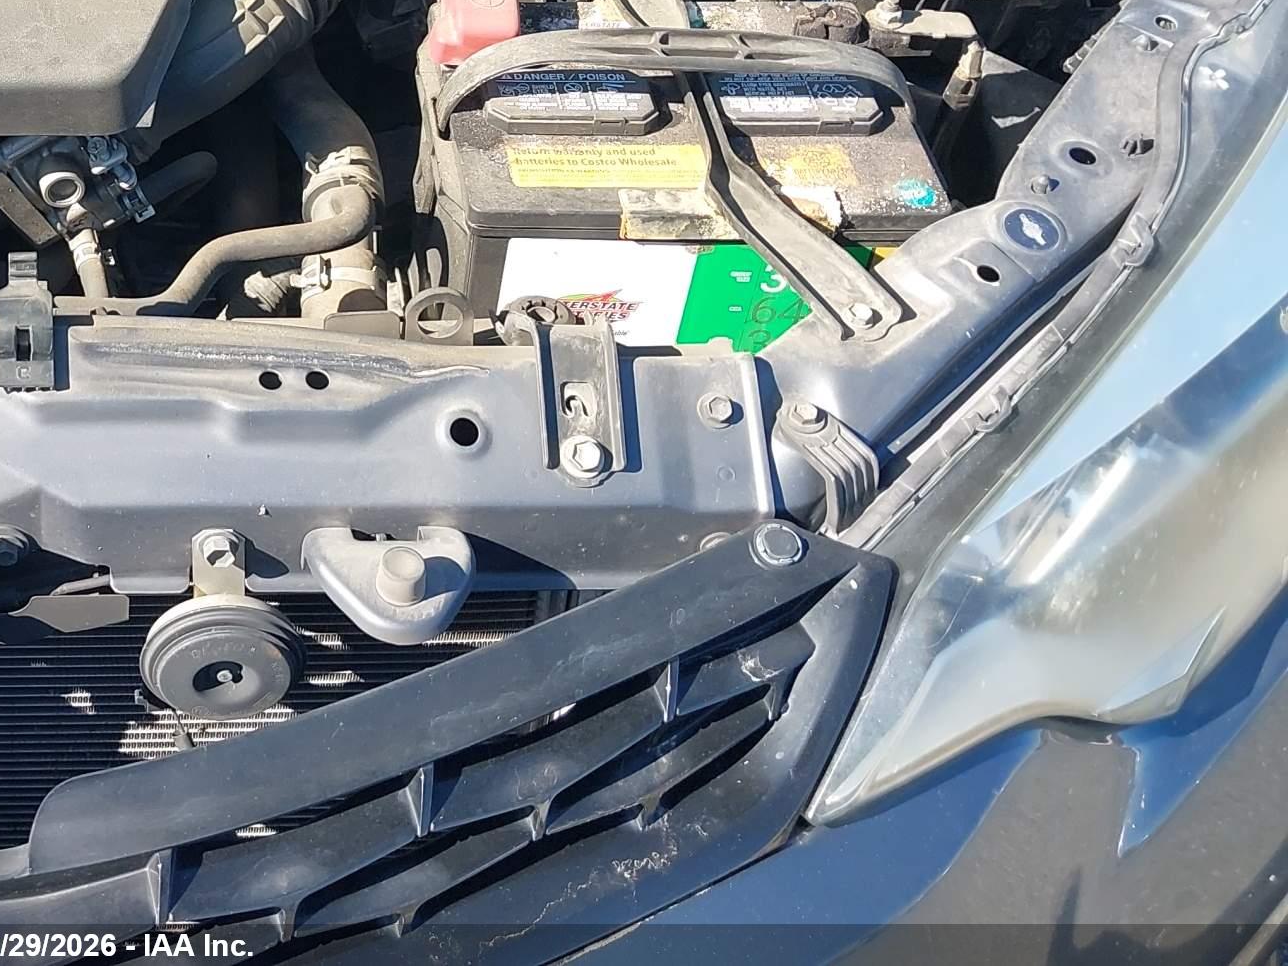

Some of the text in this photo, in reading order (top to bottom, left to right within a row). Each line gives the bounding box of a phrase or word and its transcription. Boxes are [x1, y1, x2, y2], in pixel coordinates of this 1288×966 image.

[513, 73, 565, 81] DANGER
[578, 73, 625, 81] POISON
[512, 147, 656, 157] Return warranty and used
[514, 157, 566, 166] batteries
[568, 158, 578, 166] to
[581, 158, 616, 166] Costco
[563, 301, 637, 311] TERSTATE
